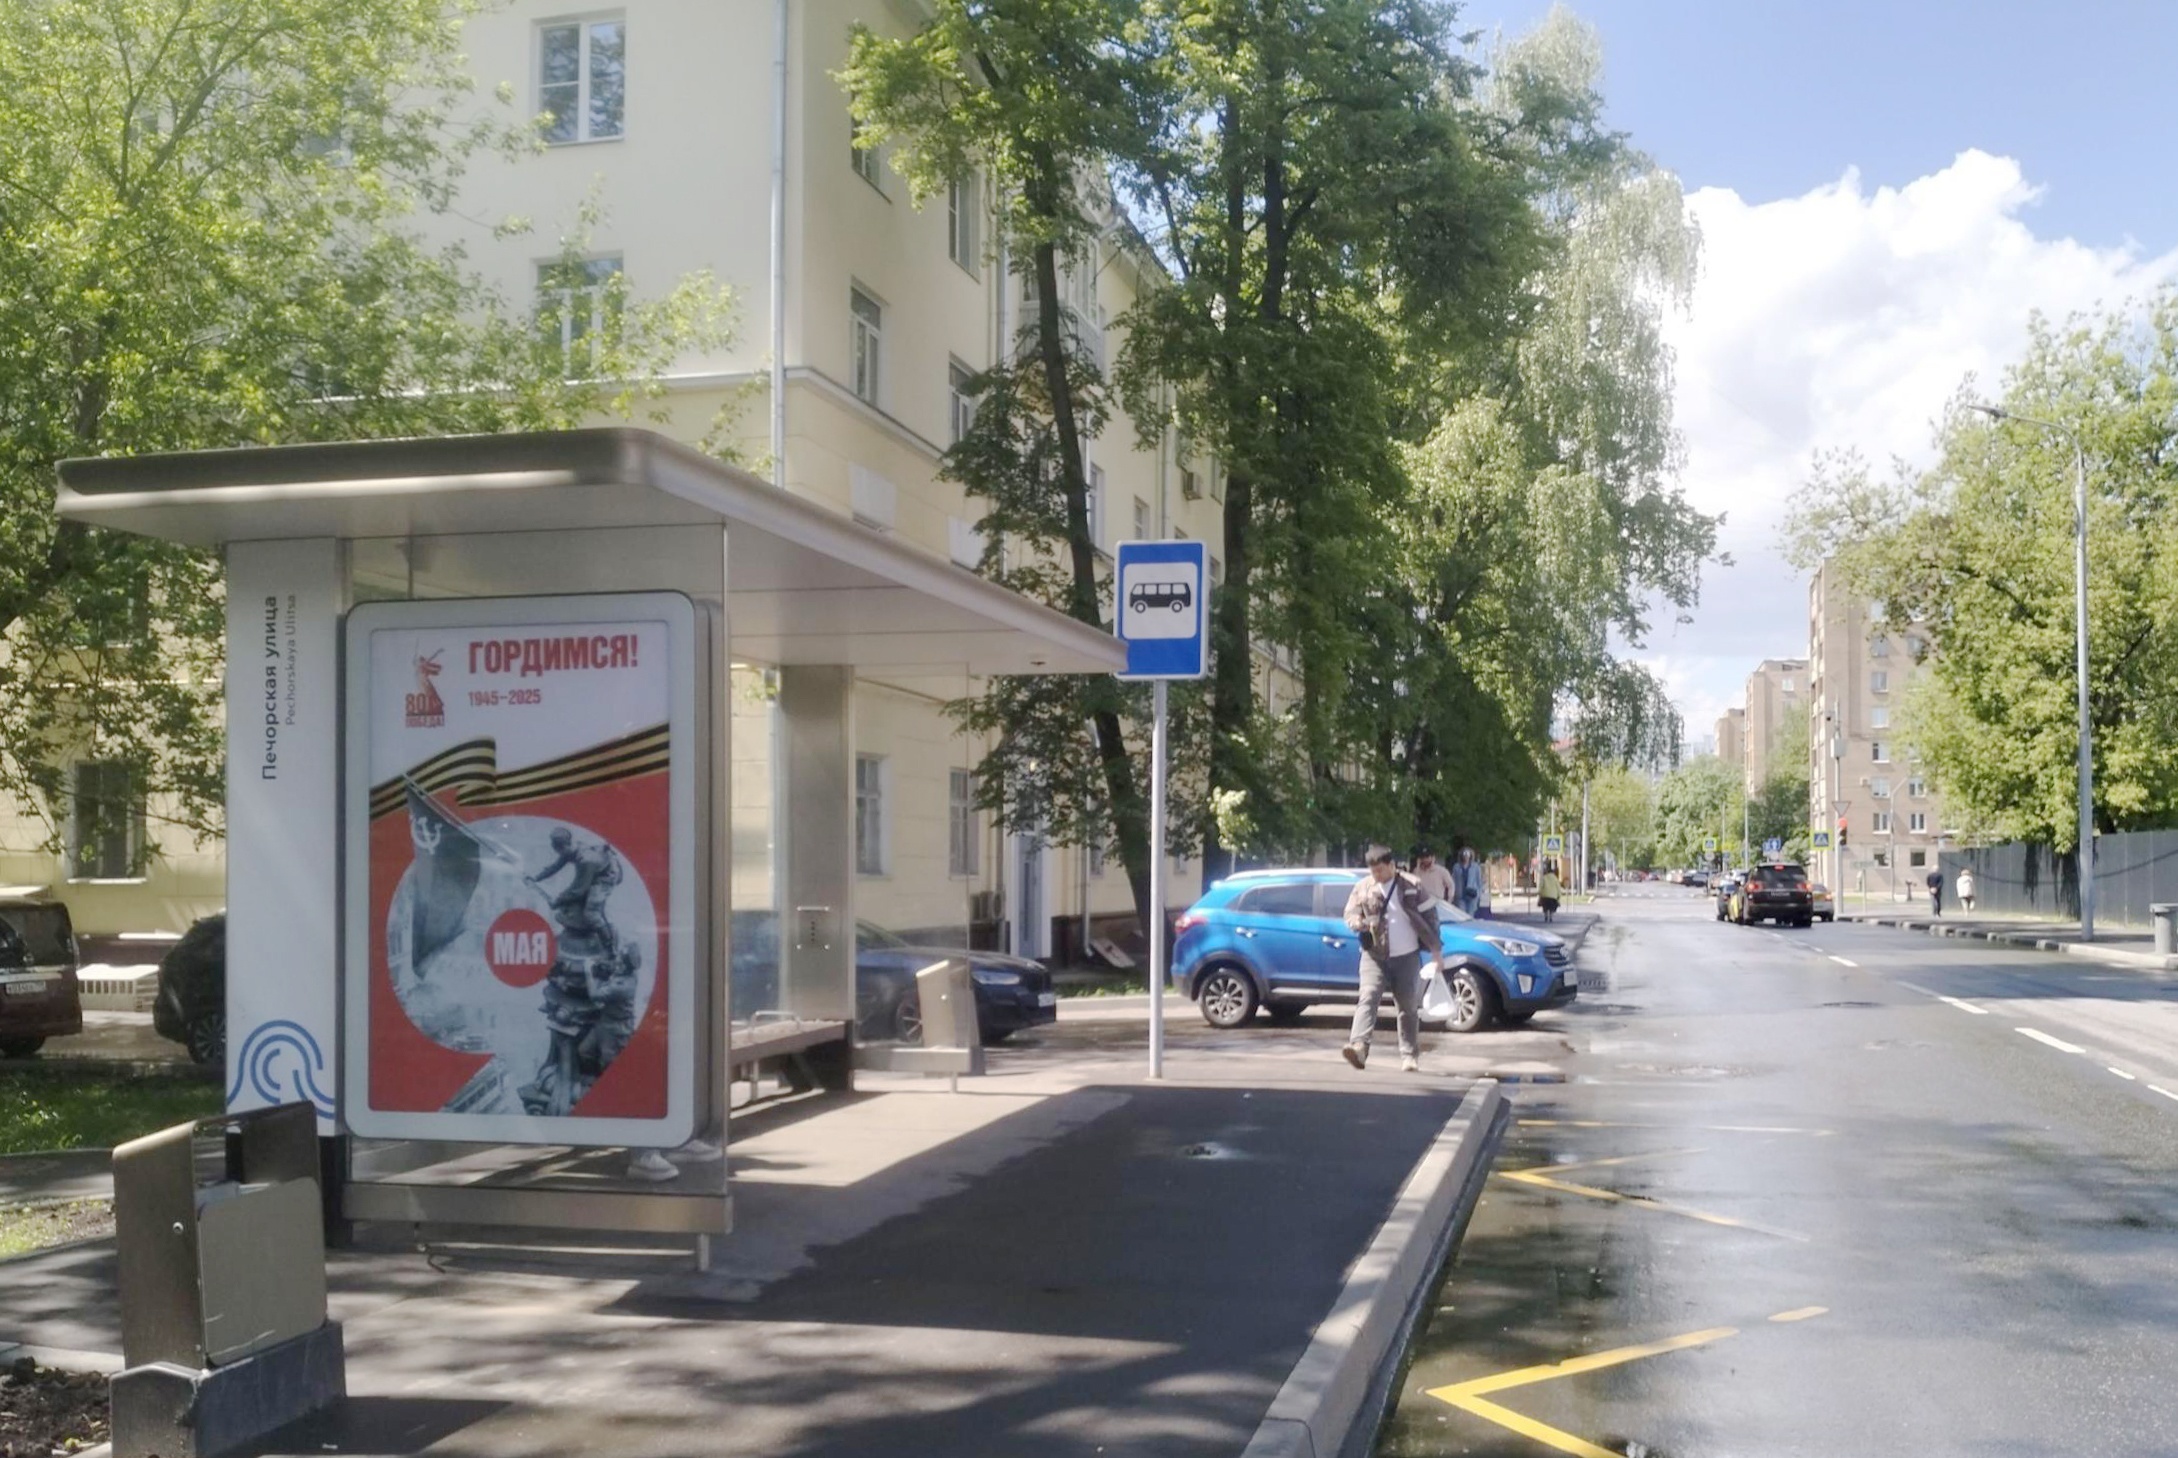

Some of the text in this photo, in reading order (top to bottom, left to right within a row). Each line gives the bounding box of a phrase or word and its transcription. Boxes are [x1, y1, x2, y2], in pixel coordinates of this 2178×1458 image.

[262, 596, 279, 780] Печорская улица
[285, 595, 297, 726] Pechorskaya Ulitsa
[468, 635, 638, 678] ГОРДИМСЯ!
[494, 932, 547, 965] МАЯ
